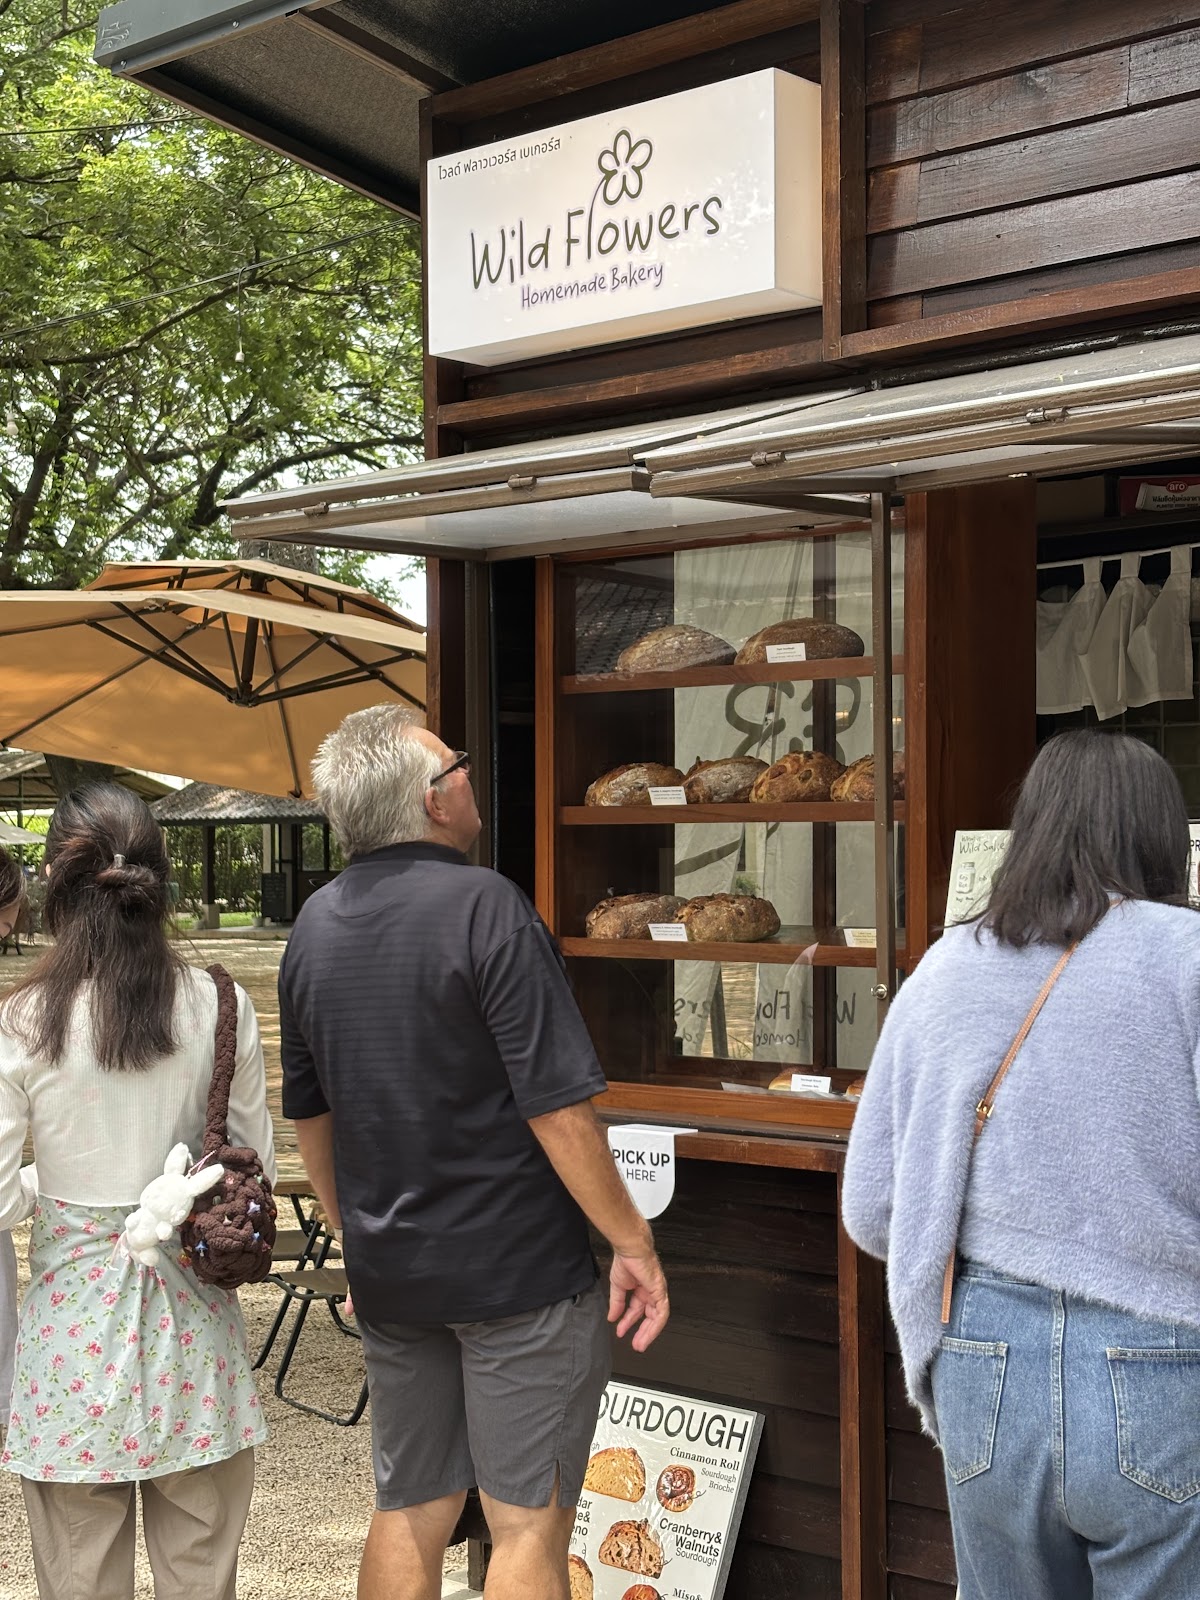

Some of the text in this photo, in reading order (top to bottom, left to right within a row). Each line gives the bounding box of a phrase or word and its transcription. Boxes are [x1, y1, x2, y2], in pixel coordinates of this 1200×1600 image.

[438, 137, 561, 180] ไวลด์ ฟลาวเวอร์ส เบเกอร์ส
[471, 186, 722, 289] Wild Flowers
[521, 263, 664, 310] Homemade Bakery
[1169, 483, 1186, 491] aro
[959, 842, 981, 854] Wild
[612, 1149, 670, 1167] PICK UP
[626, 1168, 656, 1182] HERE
[597, 1390, 749, 1453] OURDOUGH
[670, 1446, 740, 1471] Cinnamon Roll
[701, 1467, 736, 1483] Sourdough
[708, 1480, 735, 1494] Brioche
[660, 1517, 722, 1545] Cranberry&
[675, 1534, 720, 1557] Walnuts
[675, 1546, 718, 1567] Sourdough
